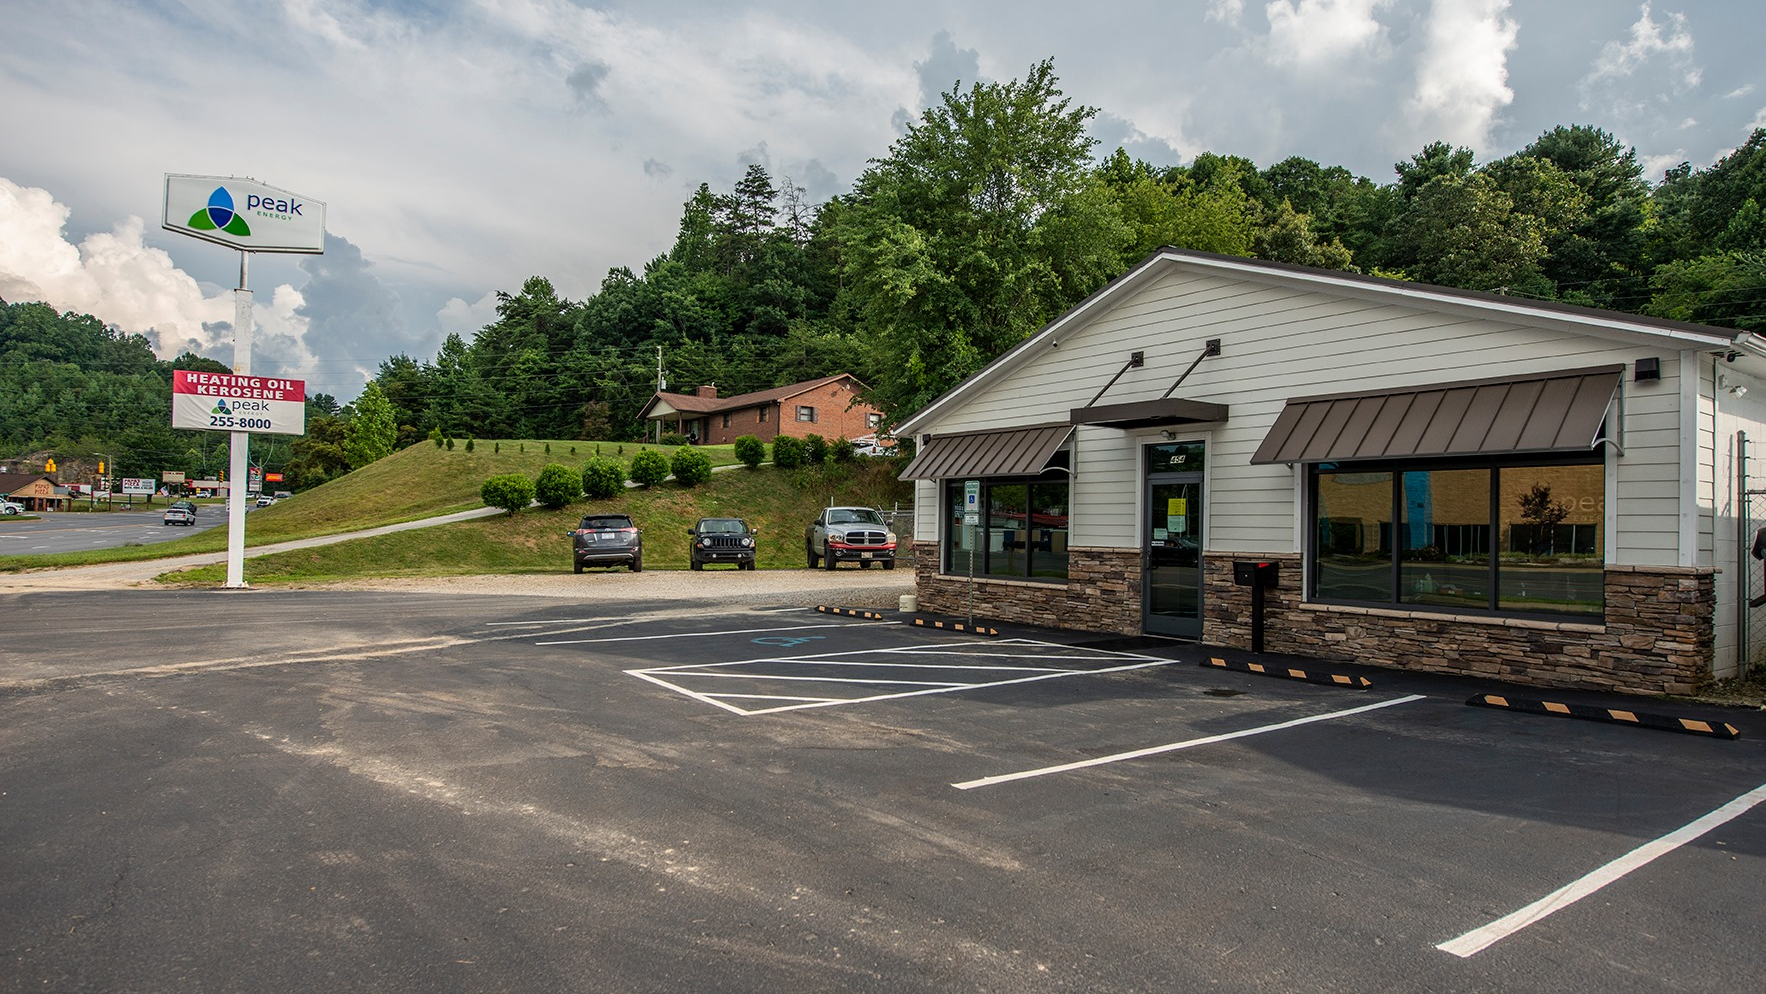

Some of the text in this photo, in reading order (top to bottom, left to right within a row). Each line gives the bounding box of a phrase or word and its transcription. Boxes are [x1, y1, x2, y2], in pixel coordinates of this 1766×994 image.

[247, 194, 303, 216] peak
[256, 211, 292, 221] ENERGY
[187, 373, 294, 390] HEATING OIL
[197, 385, 284, 400] KEROSENE
[232, 400, 270, 412] peak
[210, 416, 271, 429] 255-8000
[1170, 454, 1186, 464] 454
